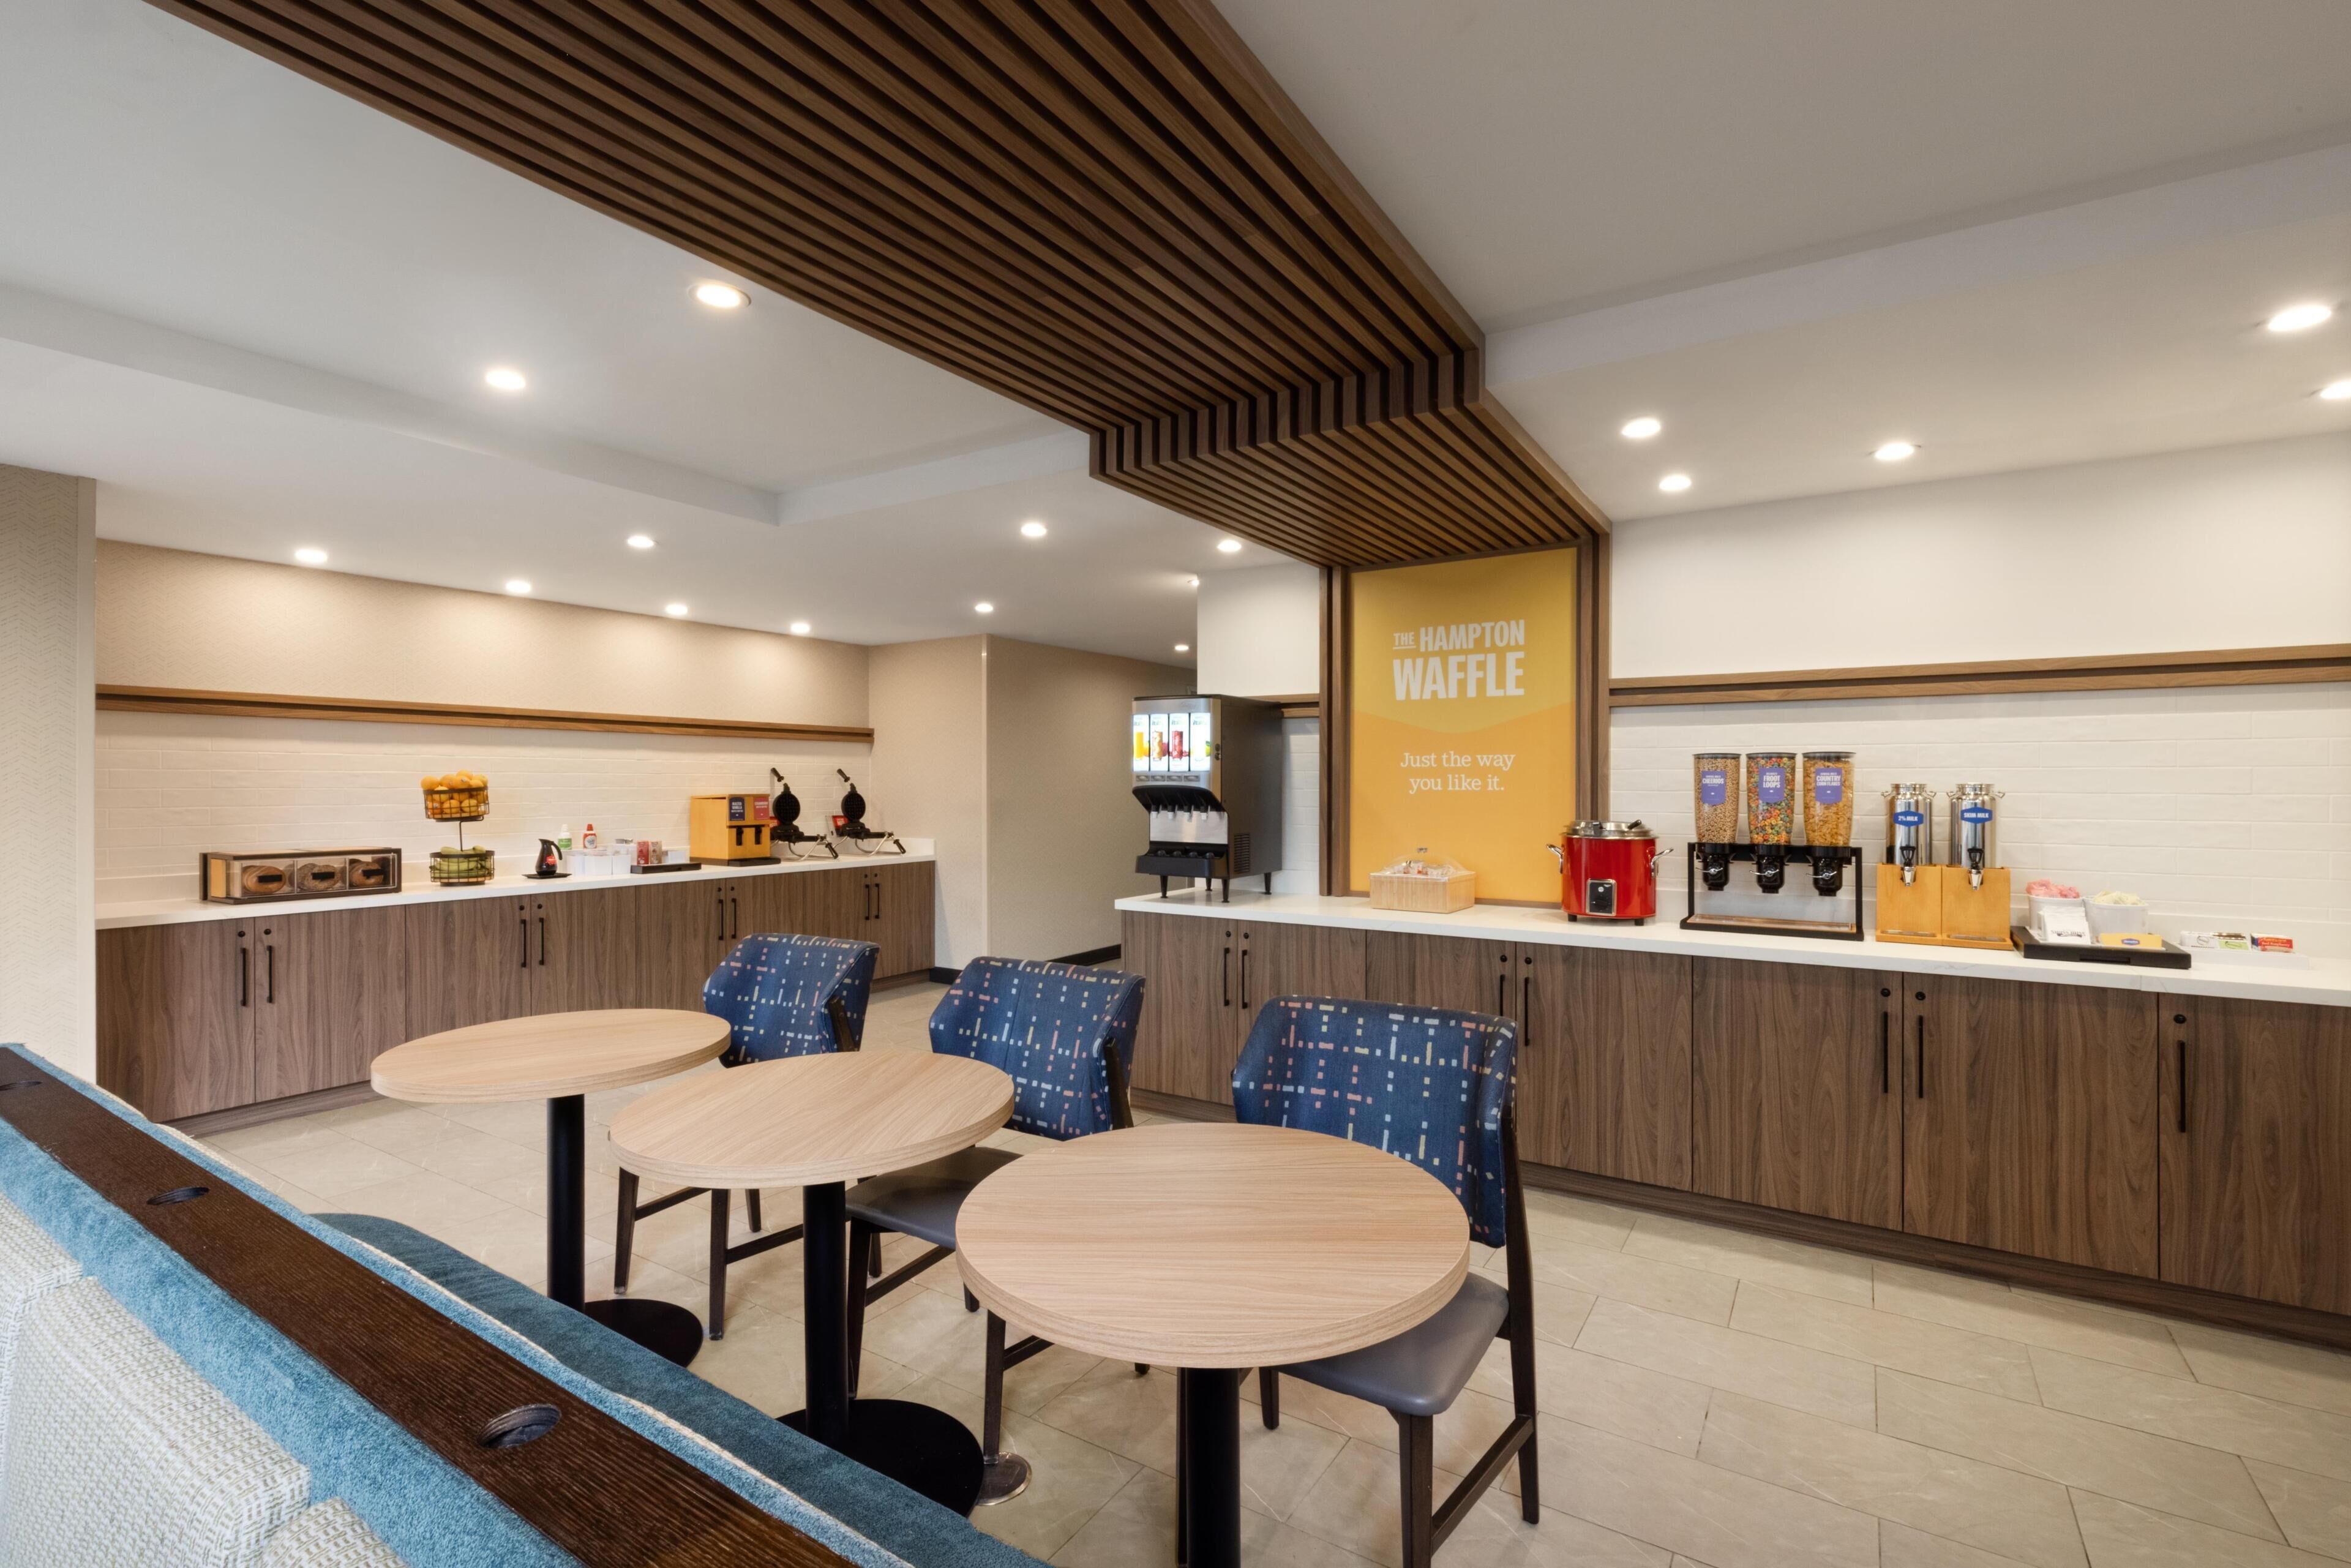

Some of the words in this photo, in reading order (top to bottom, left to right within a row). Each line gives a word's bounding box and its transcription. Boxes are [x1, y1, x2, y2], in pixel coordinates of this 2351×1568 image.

[1393, 632, 1415, 647] THE
[1420, 620, 1525, 652] HAMPTON
[1393, 651, 1524, 700] WAFFLE
[1400, 752, 1436, 768] Just
[1442, 751, 1471, 767] the
[1476, 754, 1515, 771] way
[1409, 776, 1442, 794] you
[1447, 774, 1482, 790] like
[1487, 775, 1504, 790] it.
